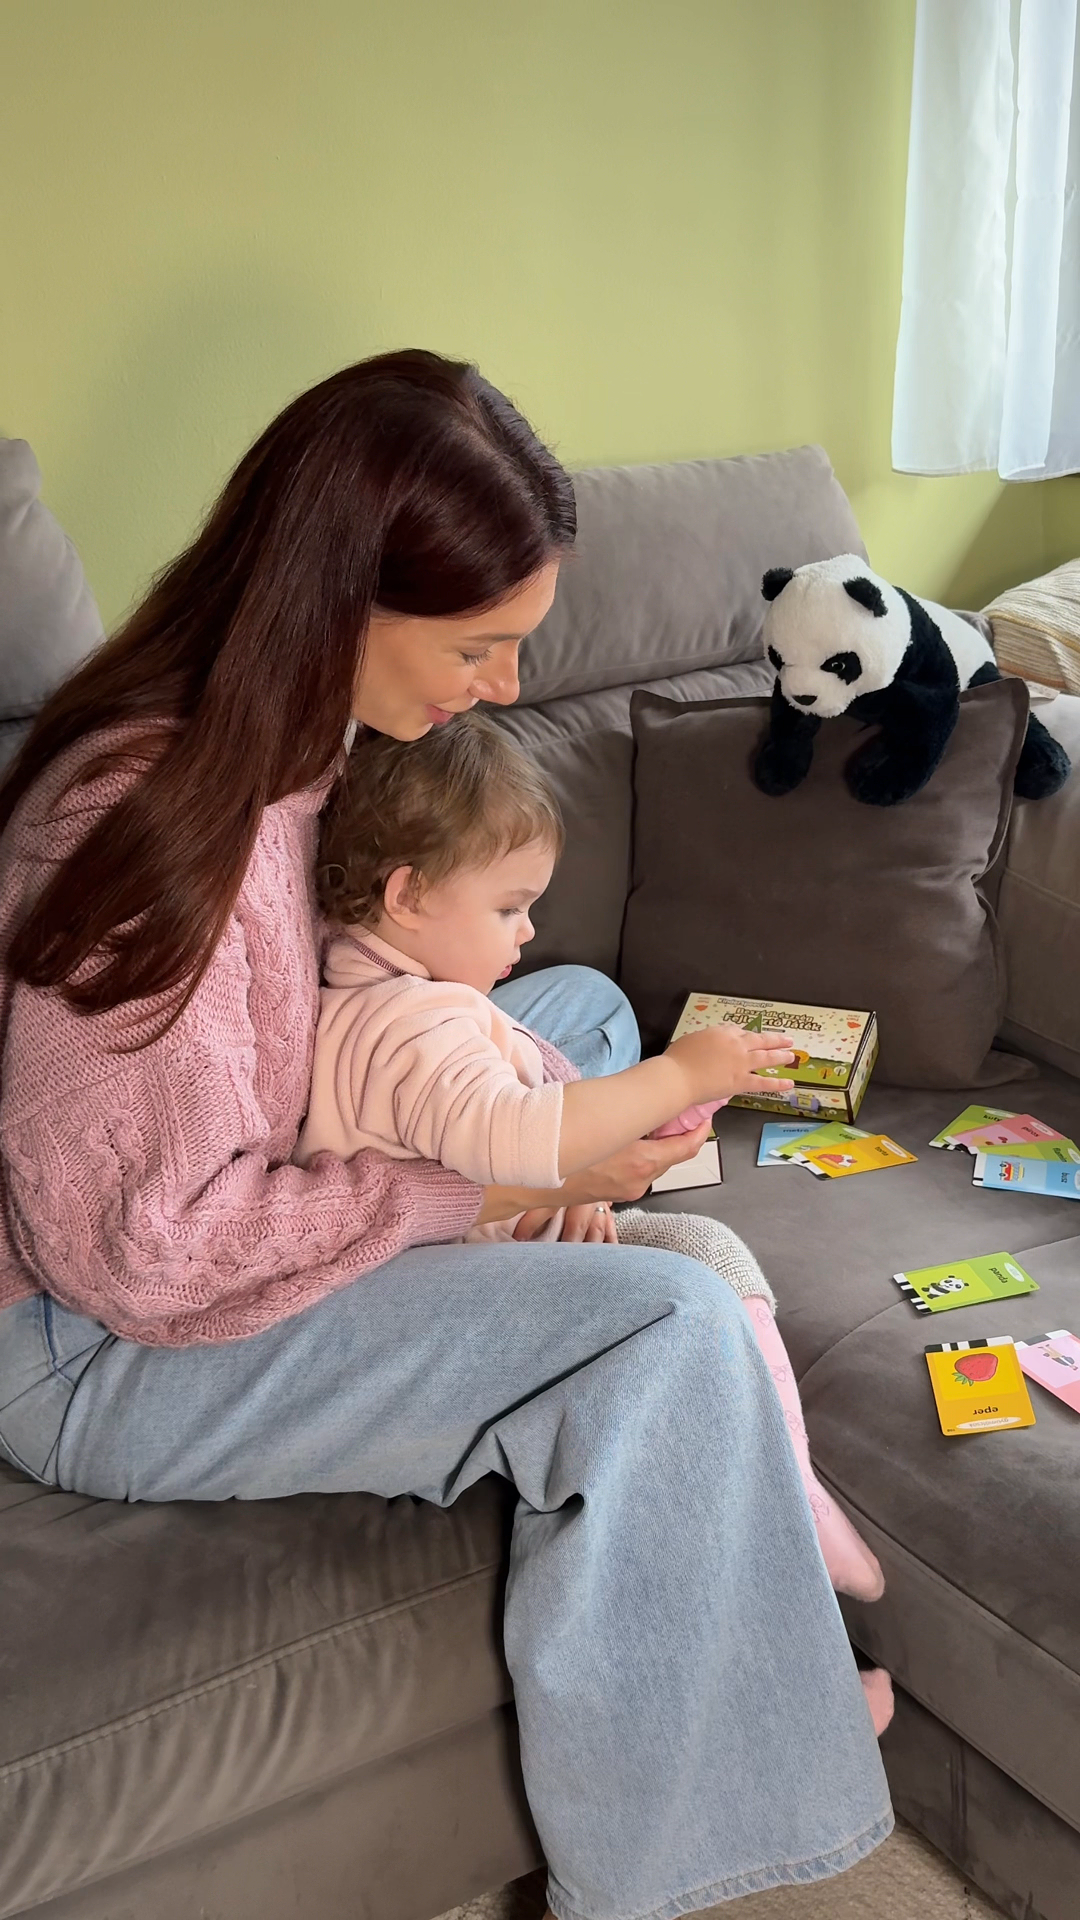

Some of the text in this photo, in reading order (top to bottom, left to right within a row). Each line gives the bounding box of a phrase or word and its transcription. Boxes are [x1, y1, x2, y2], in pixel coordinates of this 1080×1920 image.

[722, 1012, 822, 1032] Fejleztő Játék
[983, 1114, 1003, 1122] kuty
[1021, 1126, 1040, 1138] piros
[1061, 1172, 1070, 1183] busz
[988, 1267, 1008, 1284] panda
[972, 1406, 999, 1415] eper
